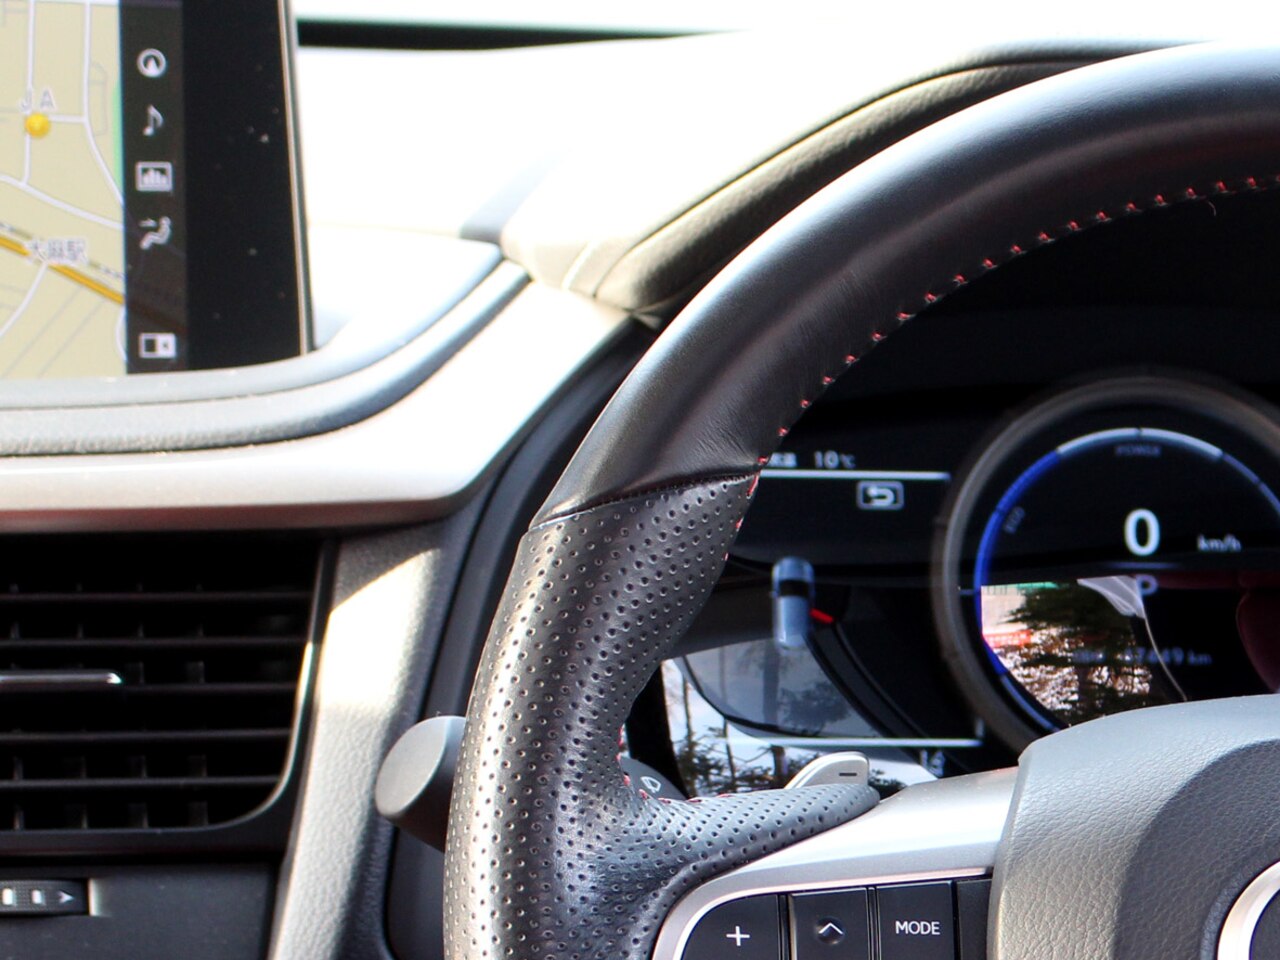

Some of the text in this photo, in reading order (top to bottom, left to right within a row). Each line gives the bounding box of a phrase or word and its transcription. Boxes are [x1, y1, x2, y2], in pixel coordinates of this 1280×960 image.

[1124, 509, 1161, 556] 0
[1197, 534, 1242, 551] km/h
[1136, 574, 1158, 600] P
[895, 921, 940, 935] MODE
